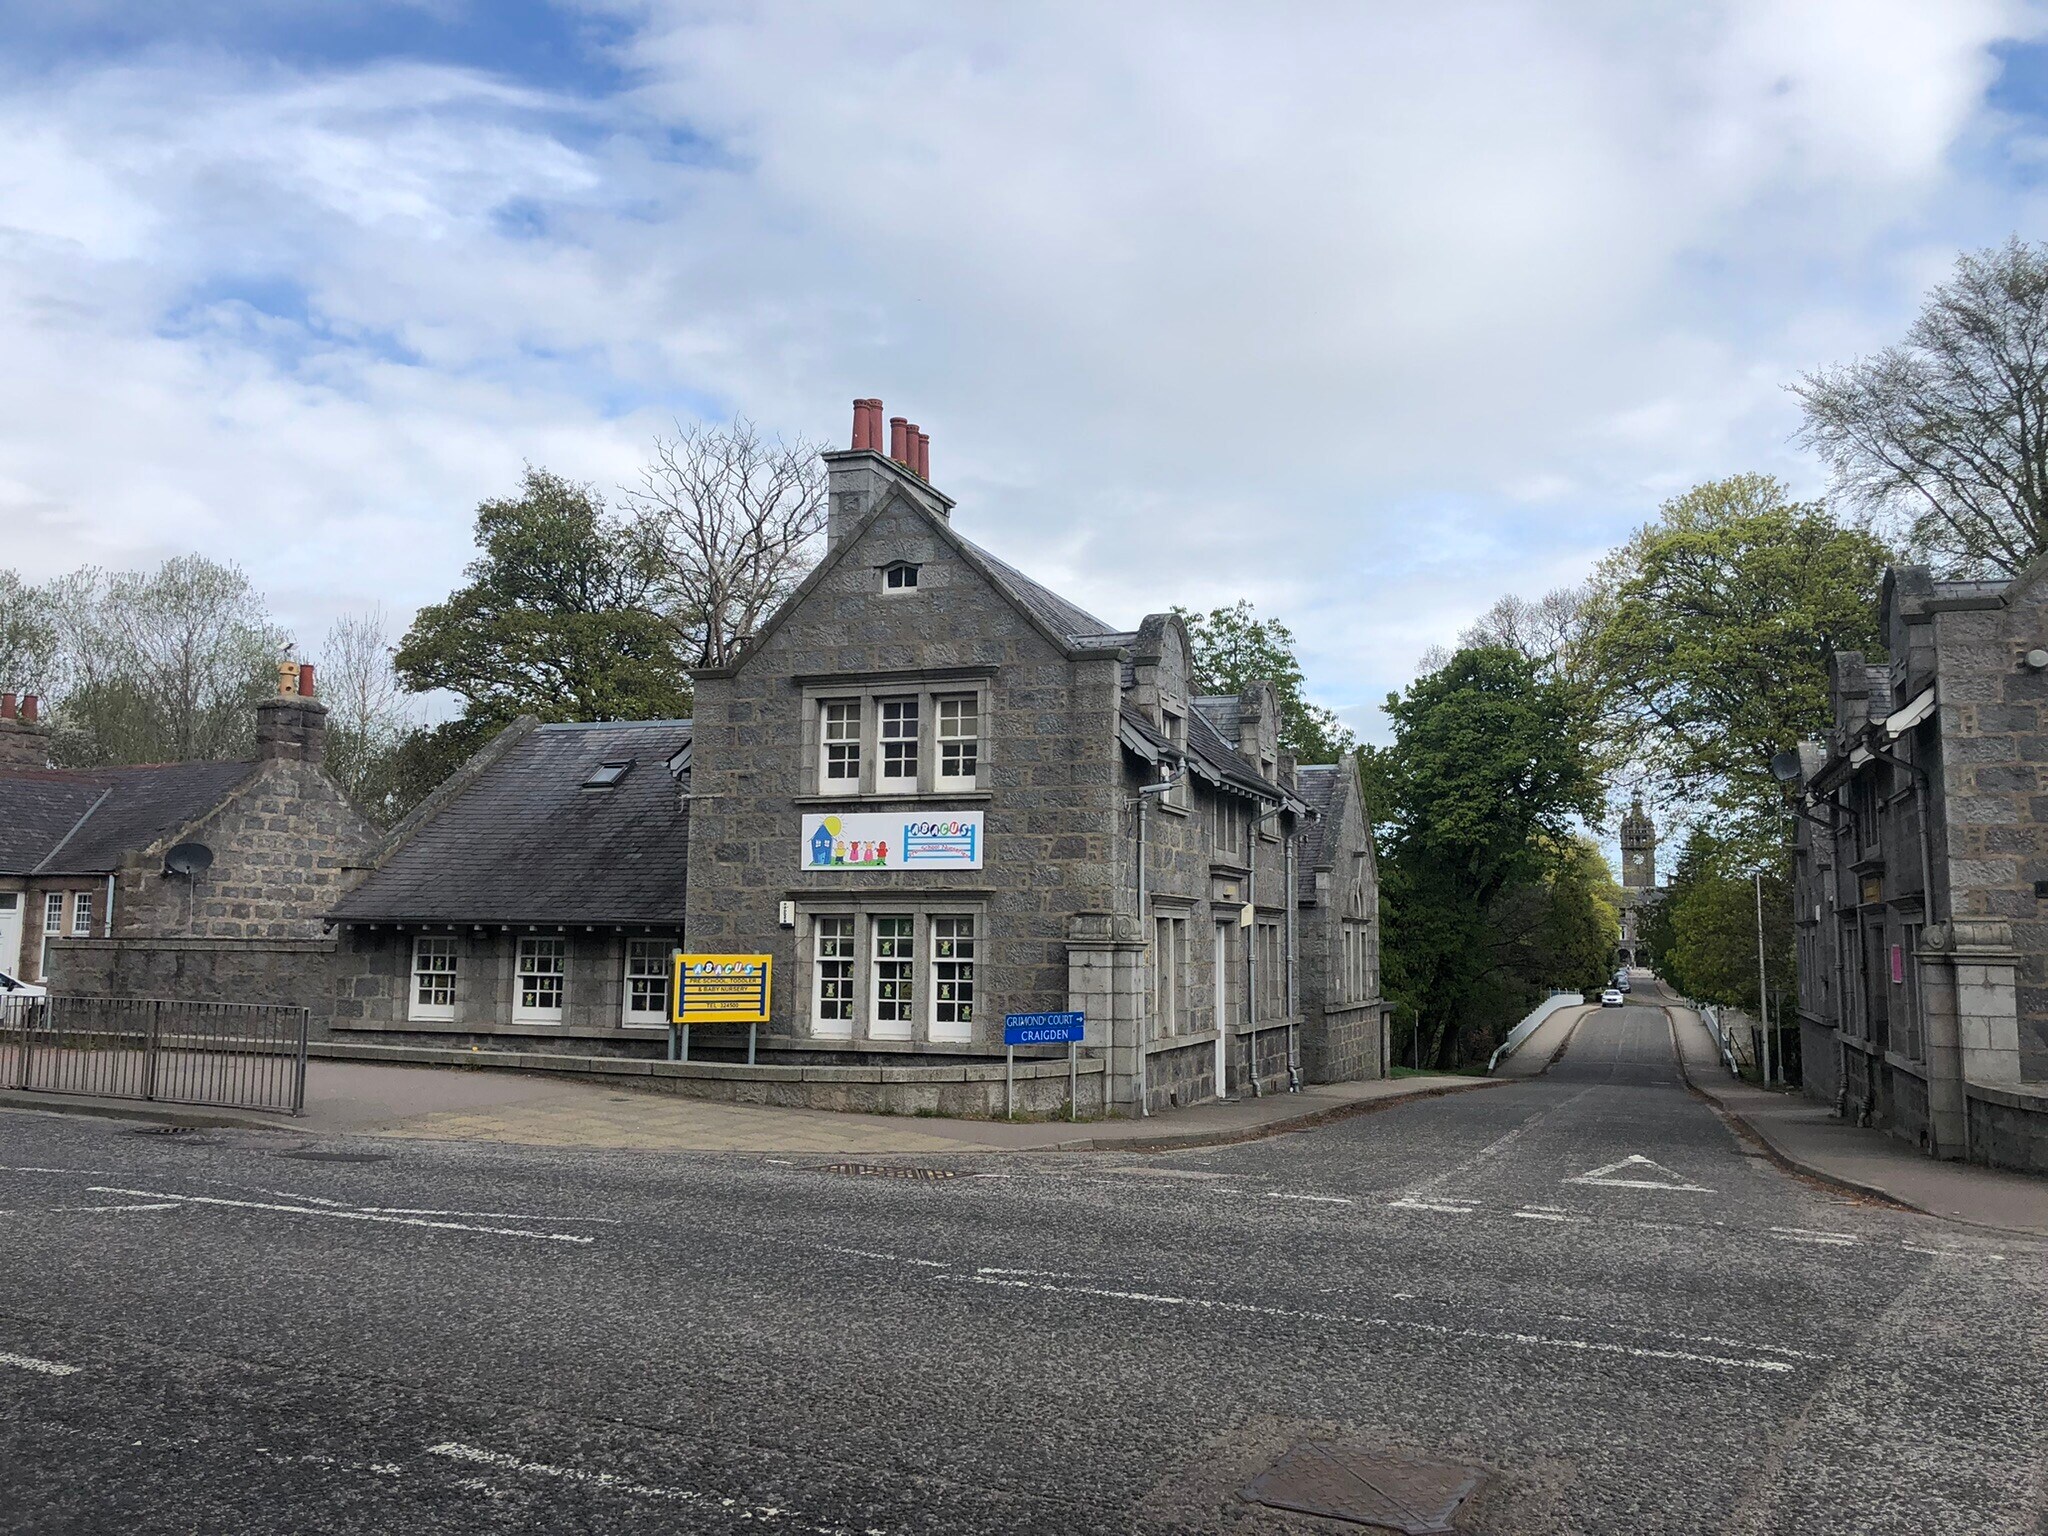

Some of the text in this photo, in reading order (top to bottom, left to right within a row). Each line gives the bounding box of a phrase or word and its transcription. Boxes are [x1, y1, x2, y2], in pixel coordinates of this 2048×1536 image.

[911, 822, 968, 837] ABACUS
[693, 961, 754, 976] ABACUS
[1006, 1015, 1074, 1027] GRIMOND COURT
[1021, 1029, 1069, 1041] CRAIGDEN
